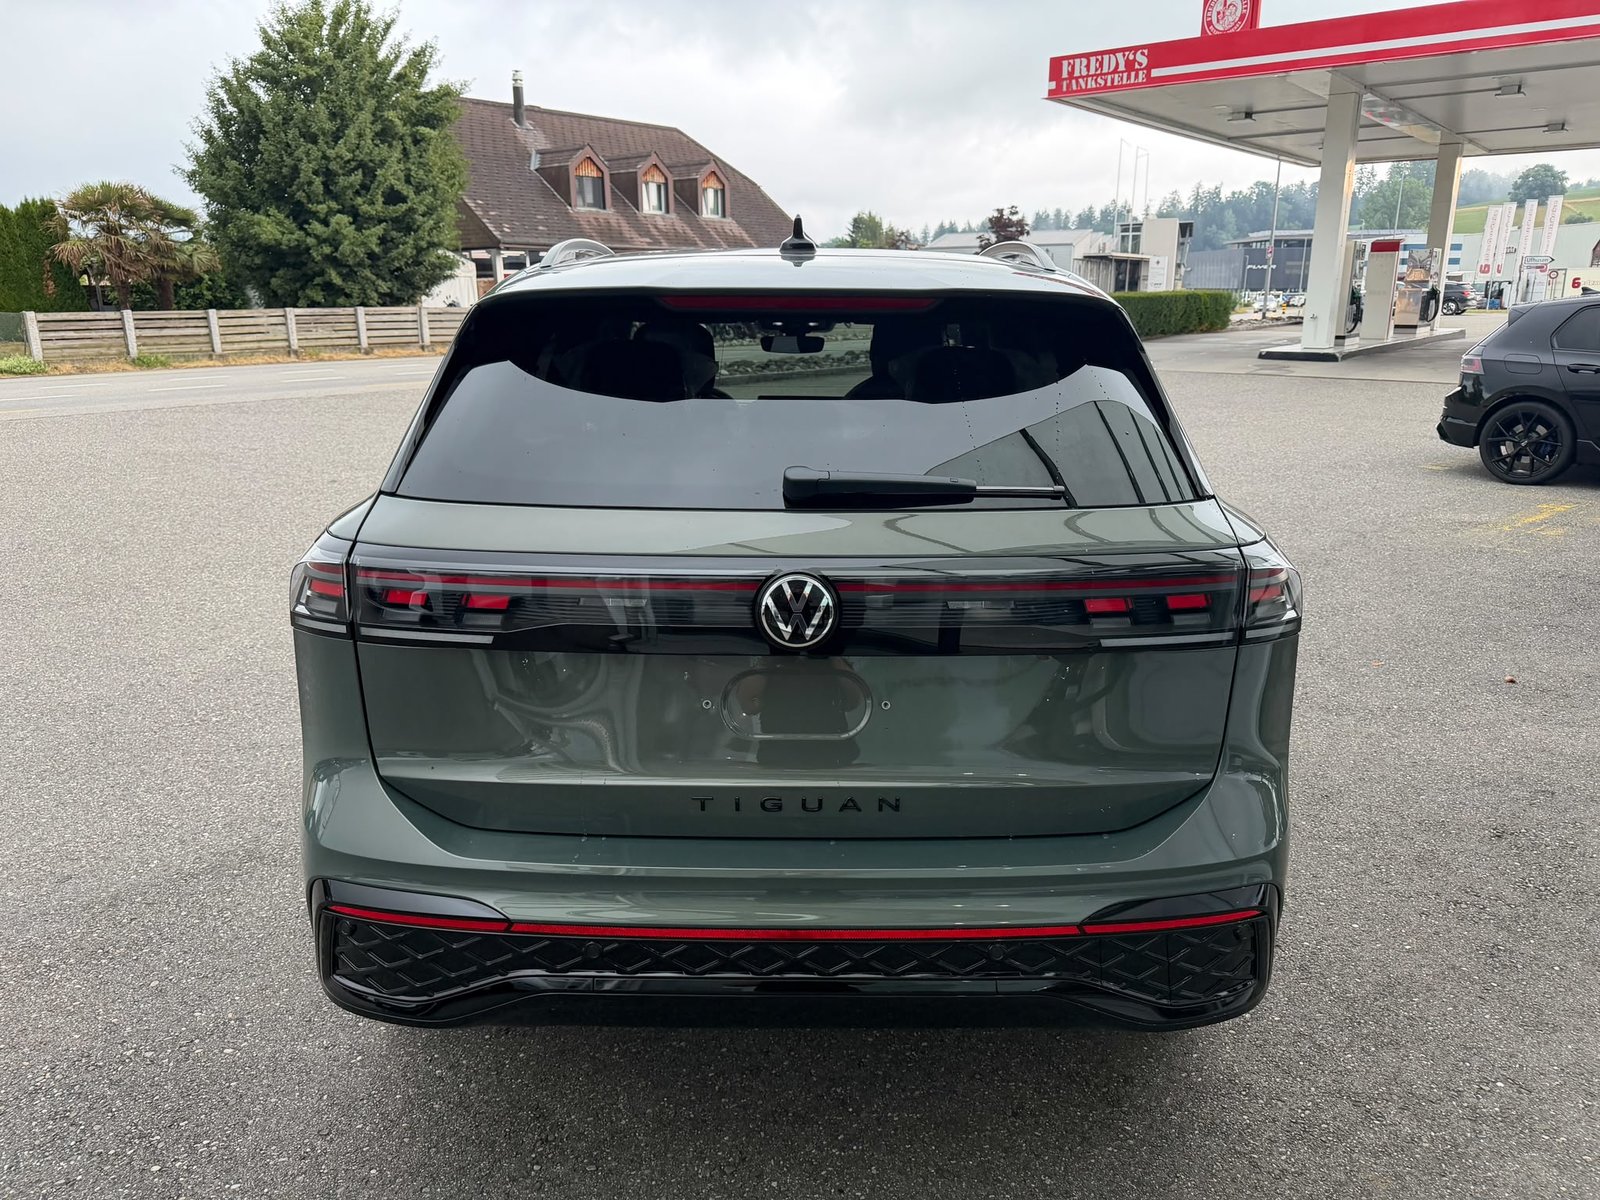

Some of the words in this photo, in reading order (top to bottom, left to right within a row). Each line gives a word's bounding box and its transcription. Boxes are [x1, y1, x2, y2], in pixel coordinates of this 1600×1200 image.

[1061, 48, 1149, 78] FREDY'S
[1061, 70, 1147, 92] TANKSTELLE
[691, 796, 902, 813] TIGUAN
